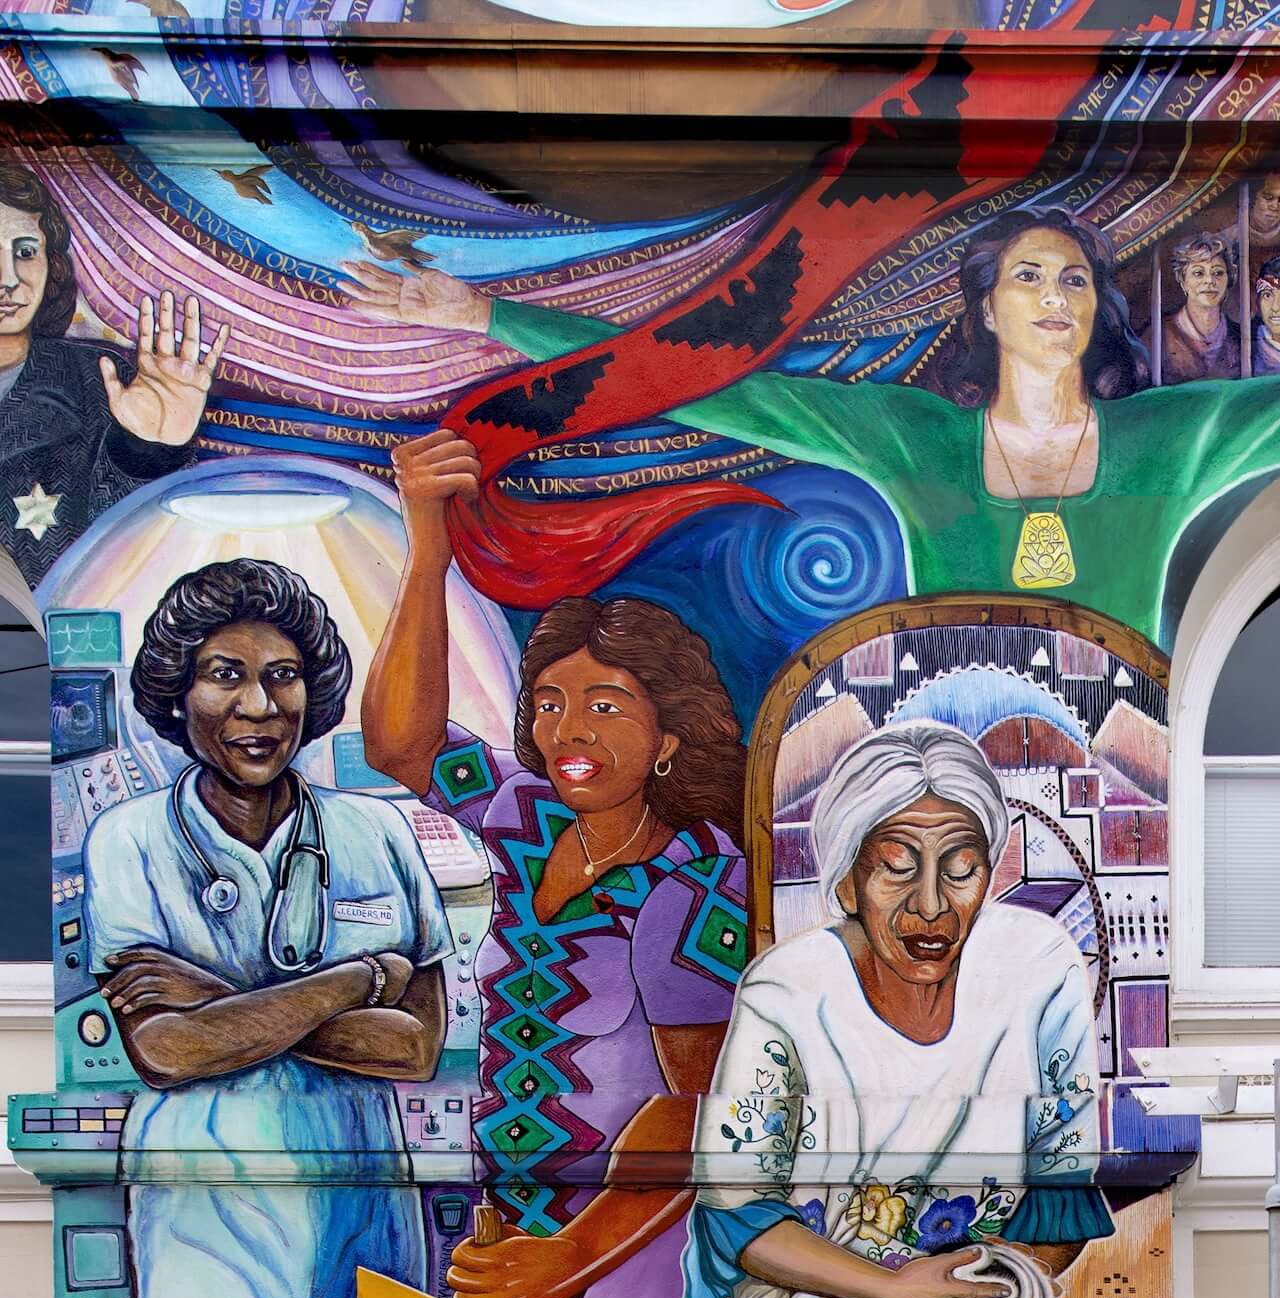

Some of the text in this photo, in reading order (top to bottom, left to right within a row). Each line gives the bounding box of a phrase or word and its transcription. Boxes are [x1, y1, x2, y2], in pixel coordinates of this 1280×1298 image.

[166, 189, 261, 258] CARMEN
[266, 252, 329, 285] ORTIZ
[486, 272, 561, 296] CAROLE
[211, 409, 314, 439] MARGARET
[537, 431, 703, 462] BETTY CULVER
[506, 459, 714, 496] NADINE GORDIMER
